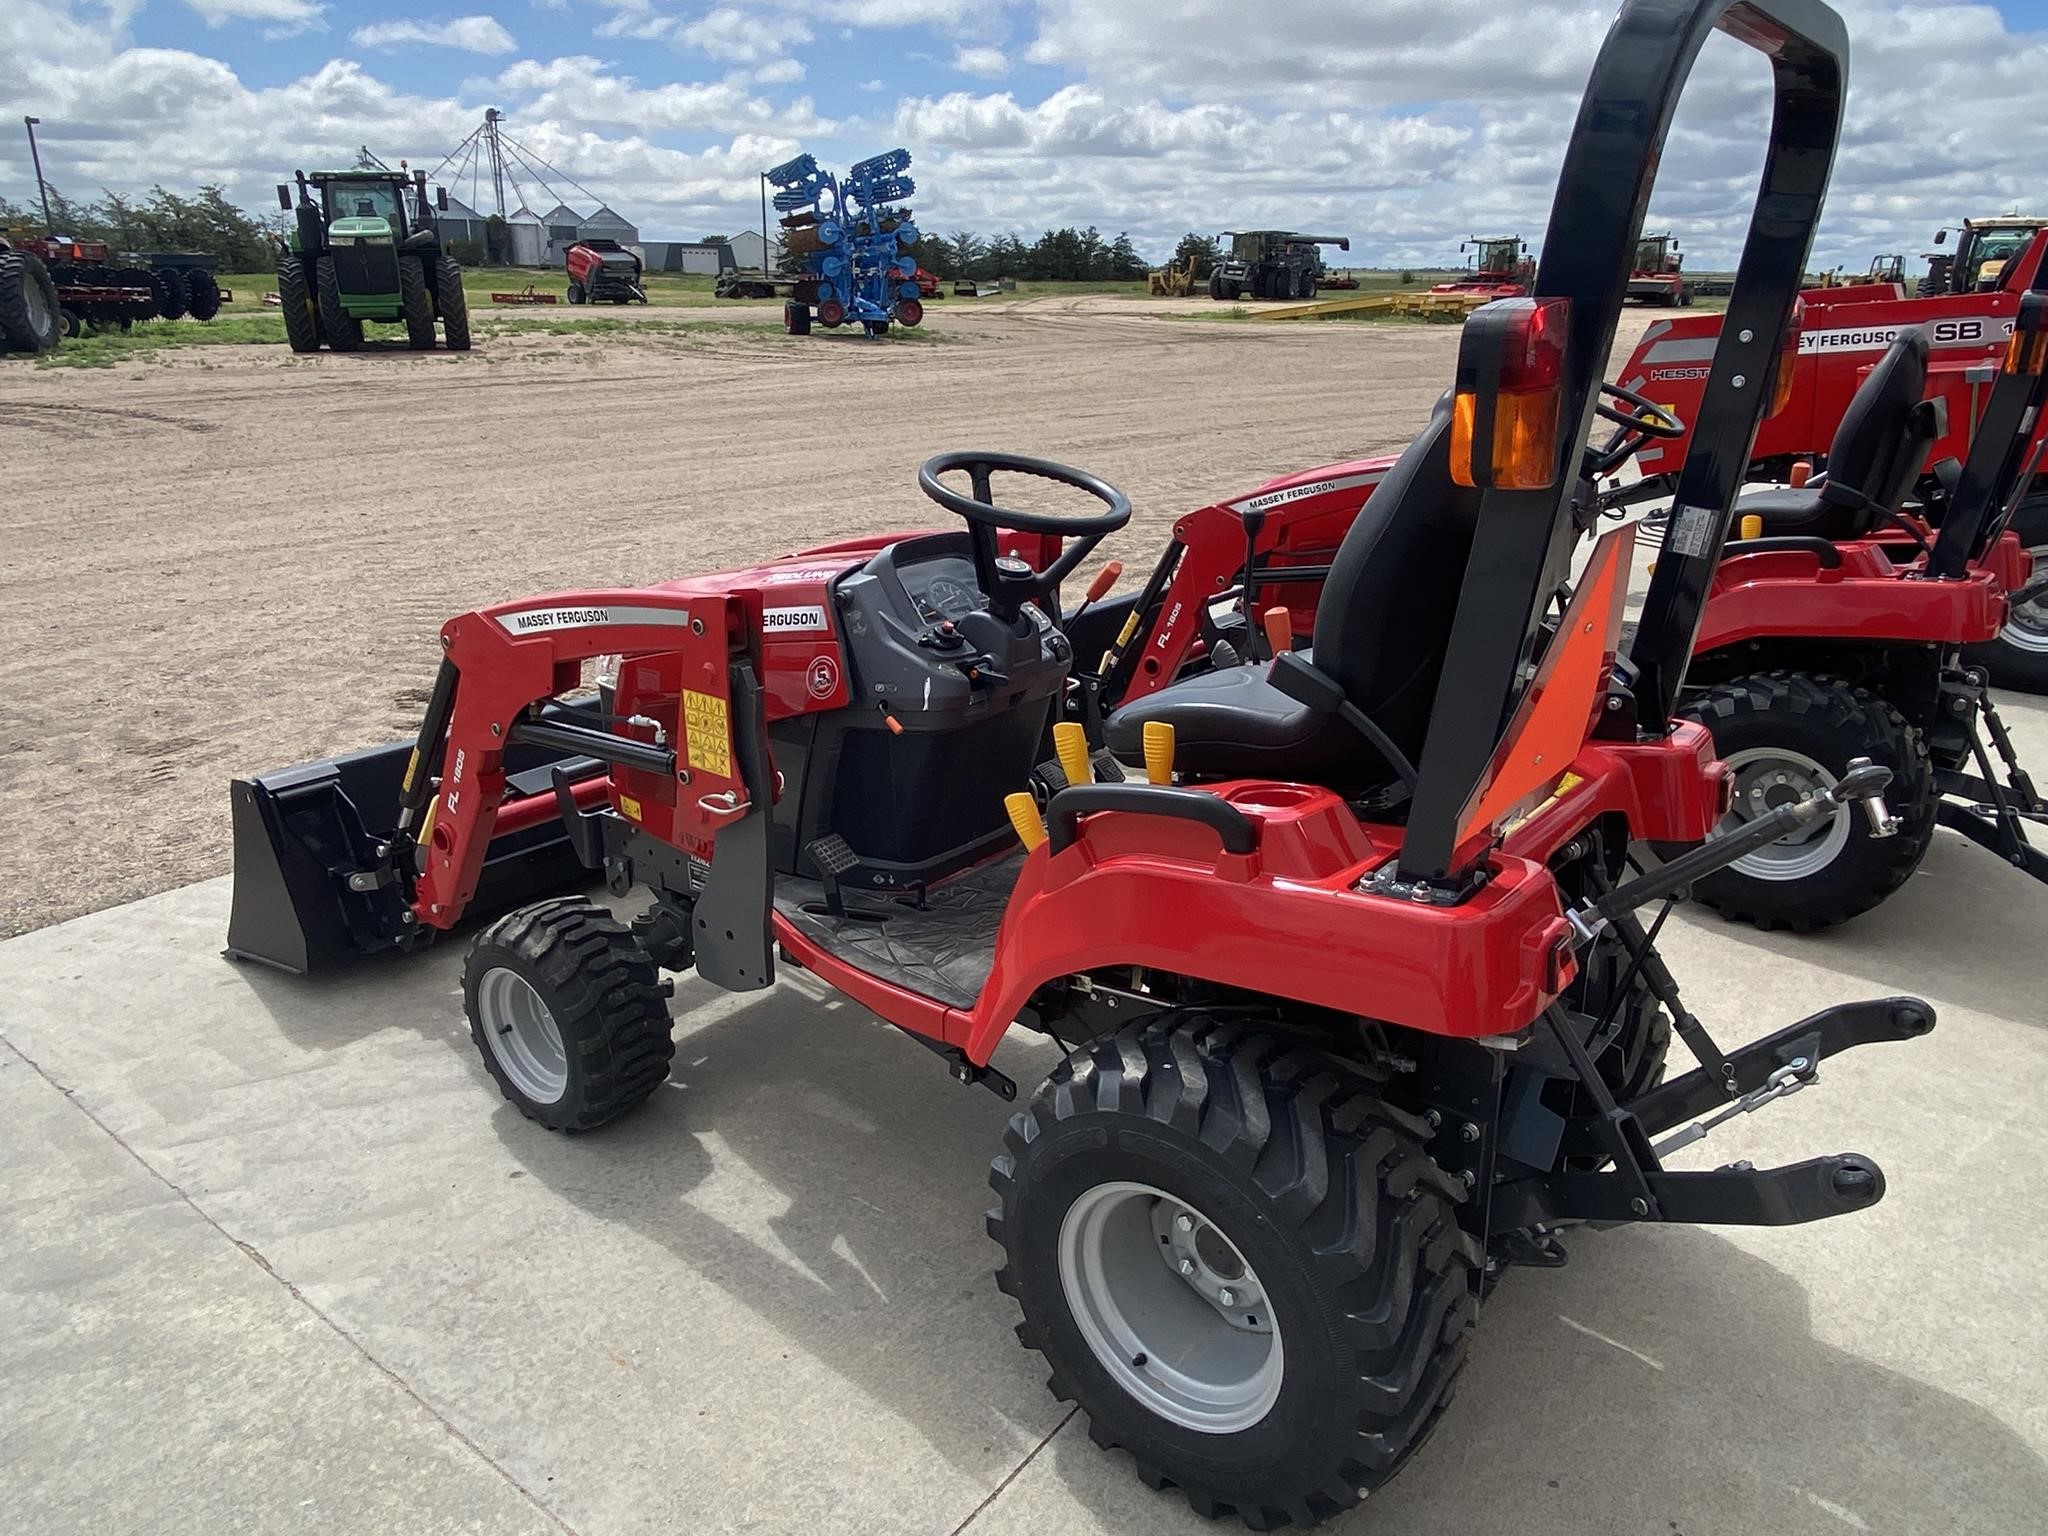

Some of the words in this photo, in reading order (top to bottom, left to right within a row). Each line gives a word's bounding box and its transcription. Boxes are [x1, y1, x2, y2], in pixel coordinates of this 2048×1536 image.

[1934, 320, 1983, 342] SB
[1249, 494, 1285, 509] MASSEY
[1287, 482, 1335, 499] FERGUSON
[517, 613, 554, 629] MASSEY
[557, 610, 608, 624] FERGUSON
[1157, 632, 1171, 649] FL
[448, 791, 459, 814] FL
